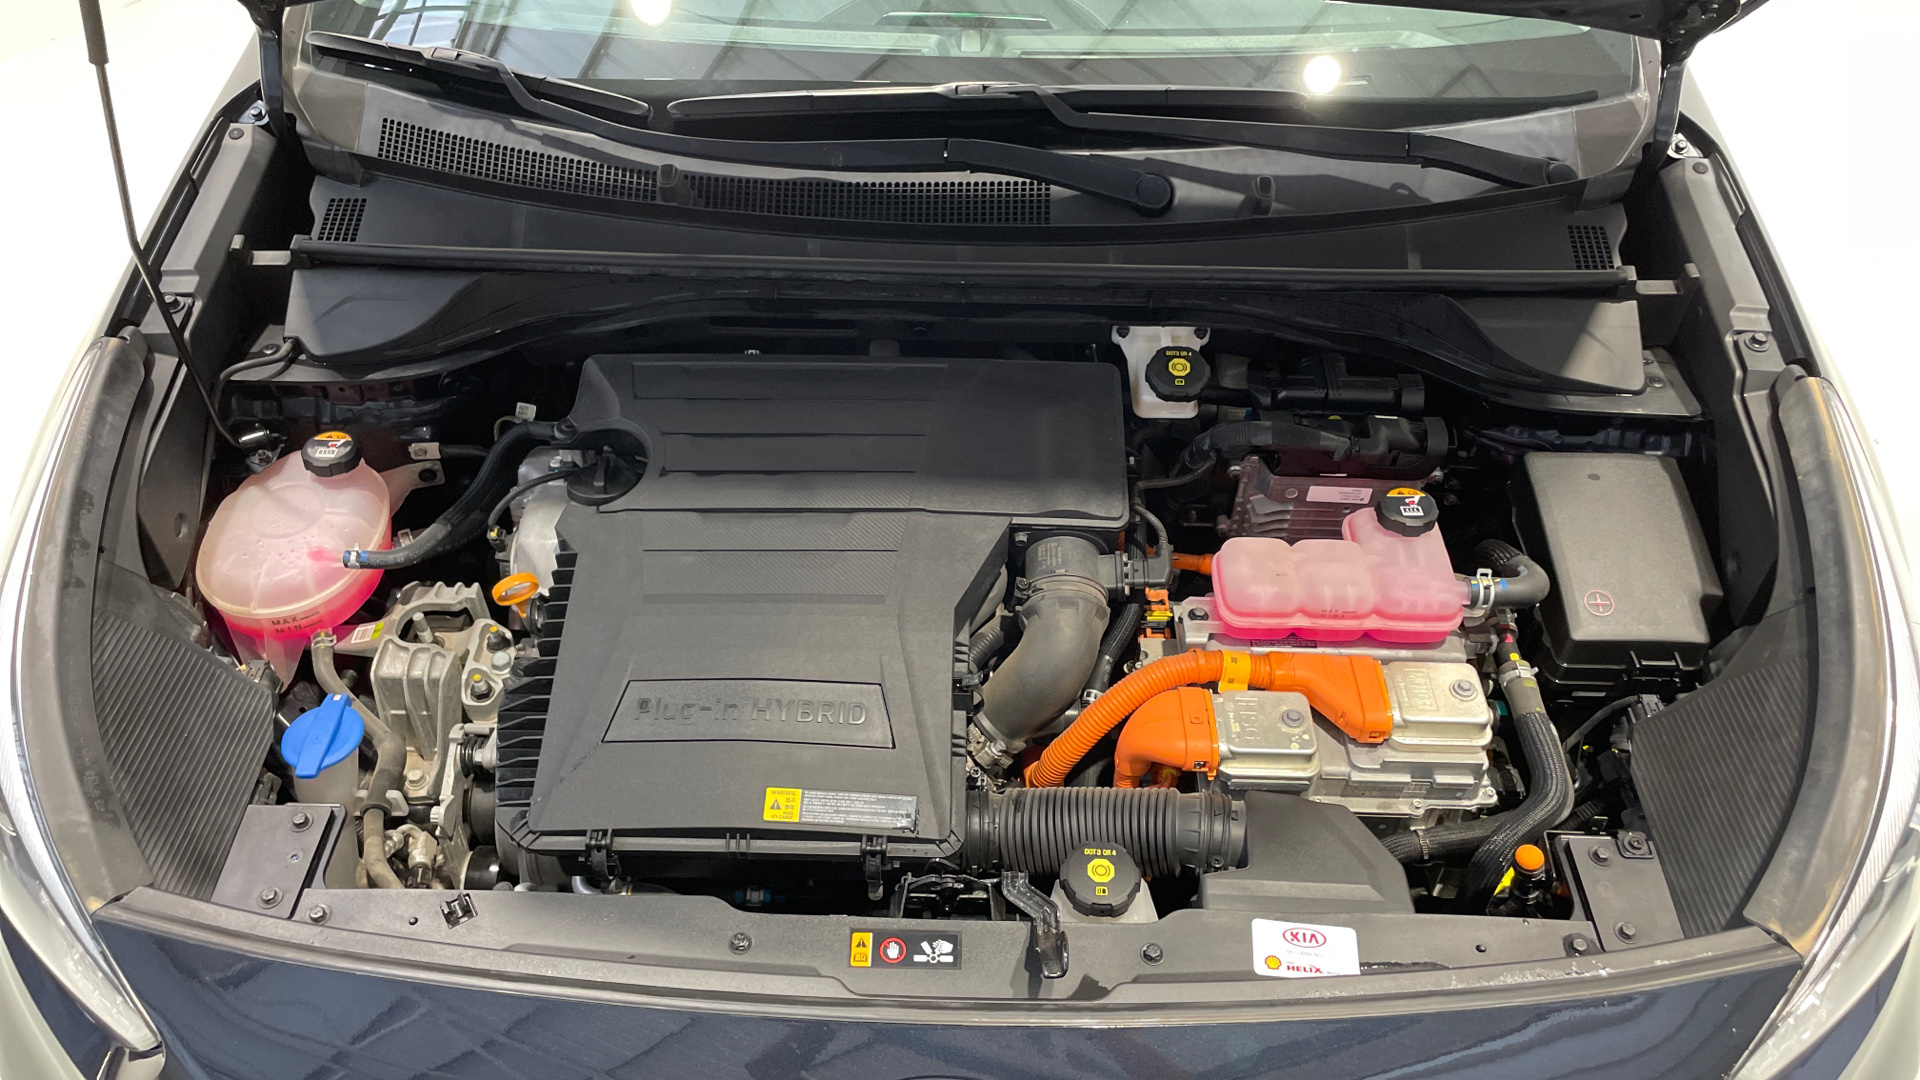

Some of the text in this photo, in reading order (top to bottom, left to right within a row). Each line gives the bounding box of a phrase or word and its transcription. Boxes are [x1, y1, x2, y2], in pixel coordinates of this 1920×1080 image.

[271, 616, 298, 627] MAX
[275, 624, 303, 634] MIN
[634, 697, 867, 726] Plug-in HYBRID
[1290, 931, 1319, 944] KIA
[1286, 965, 1324, 974] HELIX
